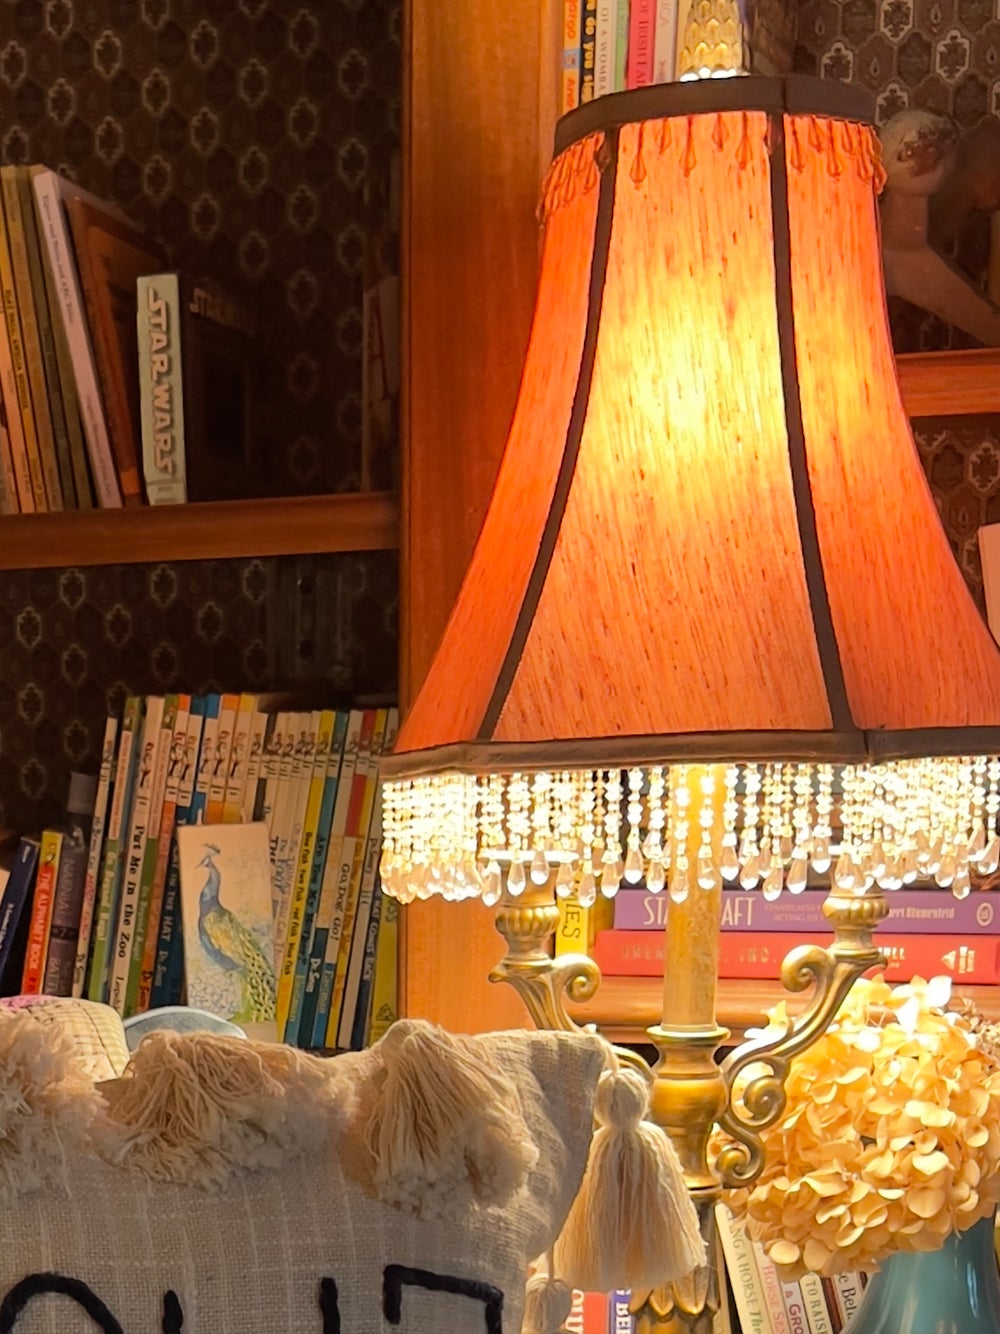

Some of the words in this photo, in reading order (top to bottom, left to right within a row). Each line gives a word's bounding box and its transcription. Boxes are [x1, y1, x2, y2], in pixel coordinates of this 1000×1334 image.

[599, 41, 608, 92] WOMBA
[147, 286, 171, 380] STAR
[152, 379, 176, 477] WARS
[132, 824, 144, 850] Put
[315, 834, 325, 857] Are
[269, 836, 278, 864] THE
[301, 848, 310, 864] fish
[129, 855, 140, 875] Me
[297, 868, 307, 883] two
[311, 862, 322, 885] You
[338, 862, 350, 884] Go,
[40, 870, 53, 891] THE
[168, 872, 177, 885] IN
[164, 889, 175, 912] THE
[295, 885, 305, 902] fish
[308, 888, 319, 907] My
[333, 884, 347, 913] Dog.
[33, 892, 50, 937] ALPHABET
[122, 903, 134, 926] the
[292, 906, 302, 920] red
[371, 900, 380, 918] HAT
[643, 896, 756, 926] STAAFT
[159, 915, 172, 943] HAT
[290, 921, 300, 938] fish
[300, 910, 315, 965] Mother?
[329, 916, 341, 942] Go!
[365, 920, 377, 953] COMES
[28, 941, 44, 971] BOOK
[117, 932, 130, 959] Zoo
[286, 941, 296, 958] blue
[283, 959, 294, 975] fish
[309, 957, 320, 969] Dr.
[304, 970, 318, 993] Seuss
[738, 1262, 758, 1305] HORSE
[762, 1263, 781, 1311] HORSE
[804, 1280, 817, 1296] TO
